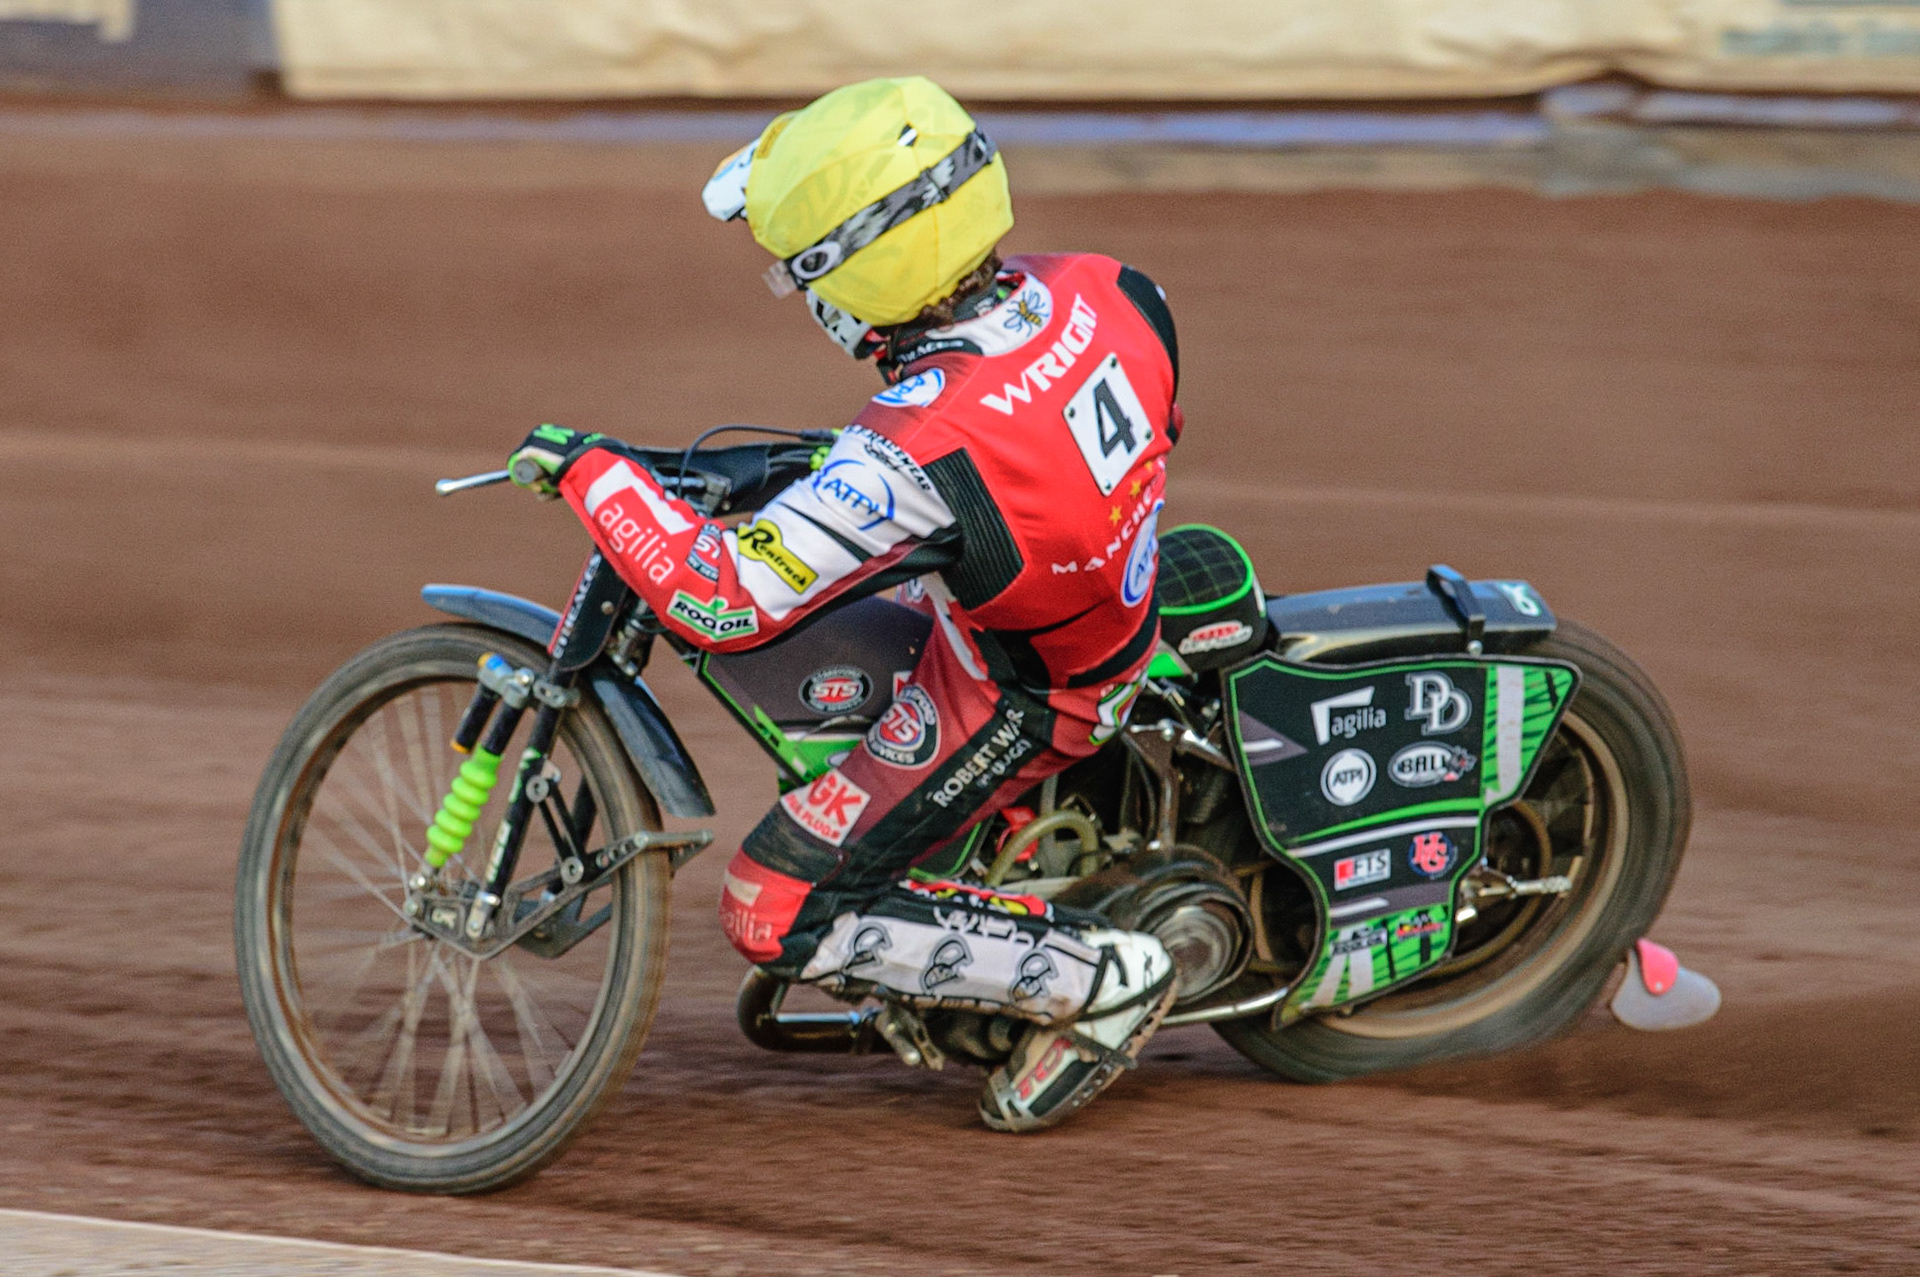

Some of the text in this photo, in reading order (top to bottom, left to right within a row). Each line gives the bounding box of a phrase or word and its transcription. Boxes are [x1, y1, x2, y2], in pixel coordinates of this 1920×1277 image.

[1093, 378, 1137, 459] 4
[599, 502, 676, 585] agilia
[720, 618, 753, 632] OIL
[813, 681, 860, 698] STS
[1331, 707, 1387, 738] agilia
[932, 743, 997, 808] ROBERT
[807, 773, 863, 828] GK
[1355, 854, 1387, 876] FTS
